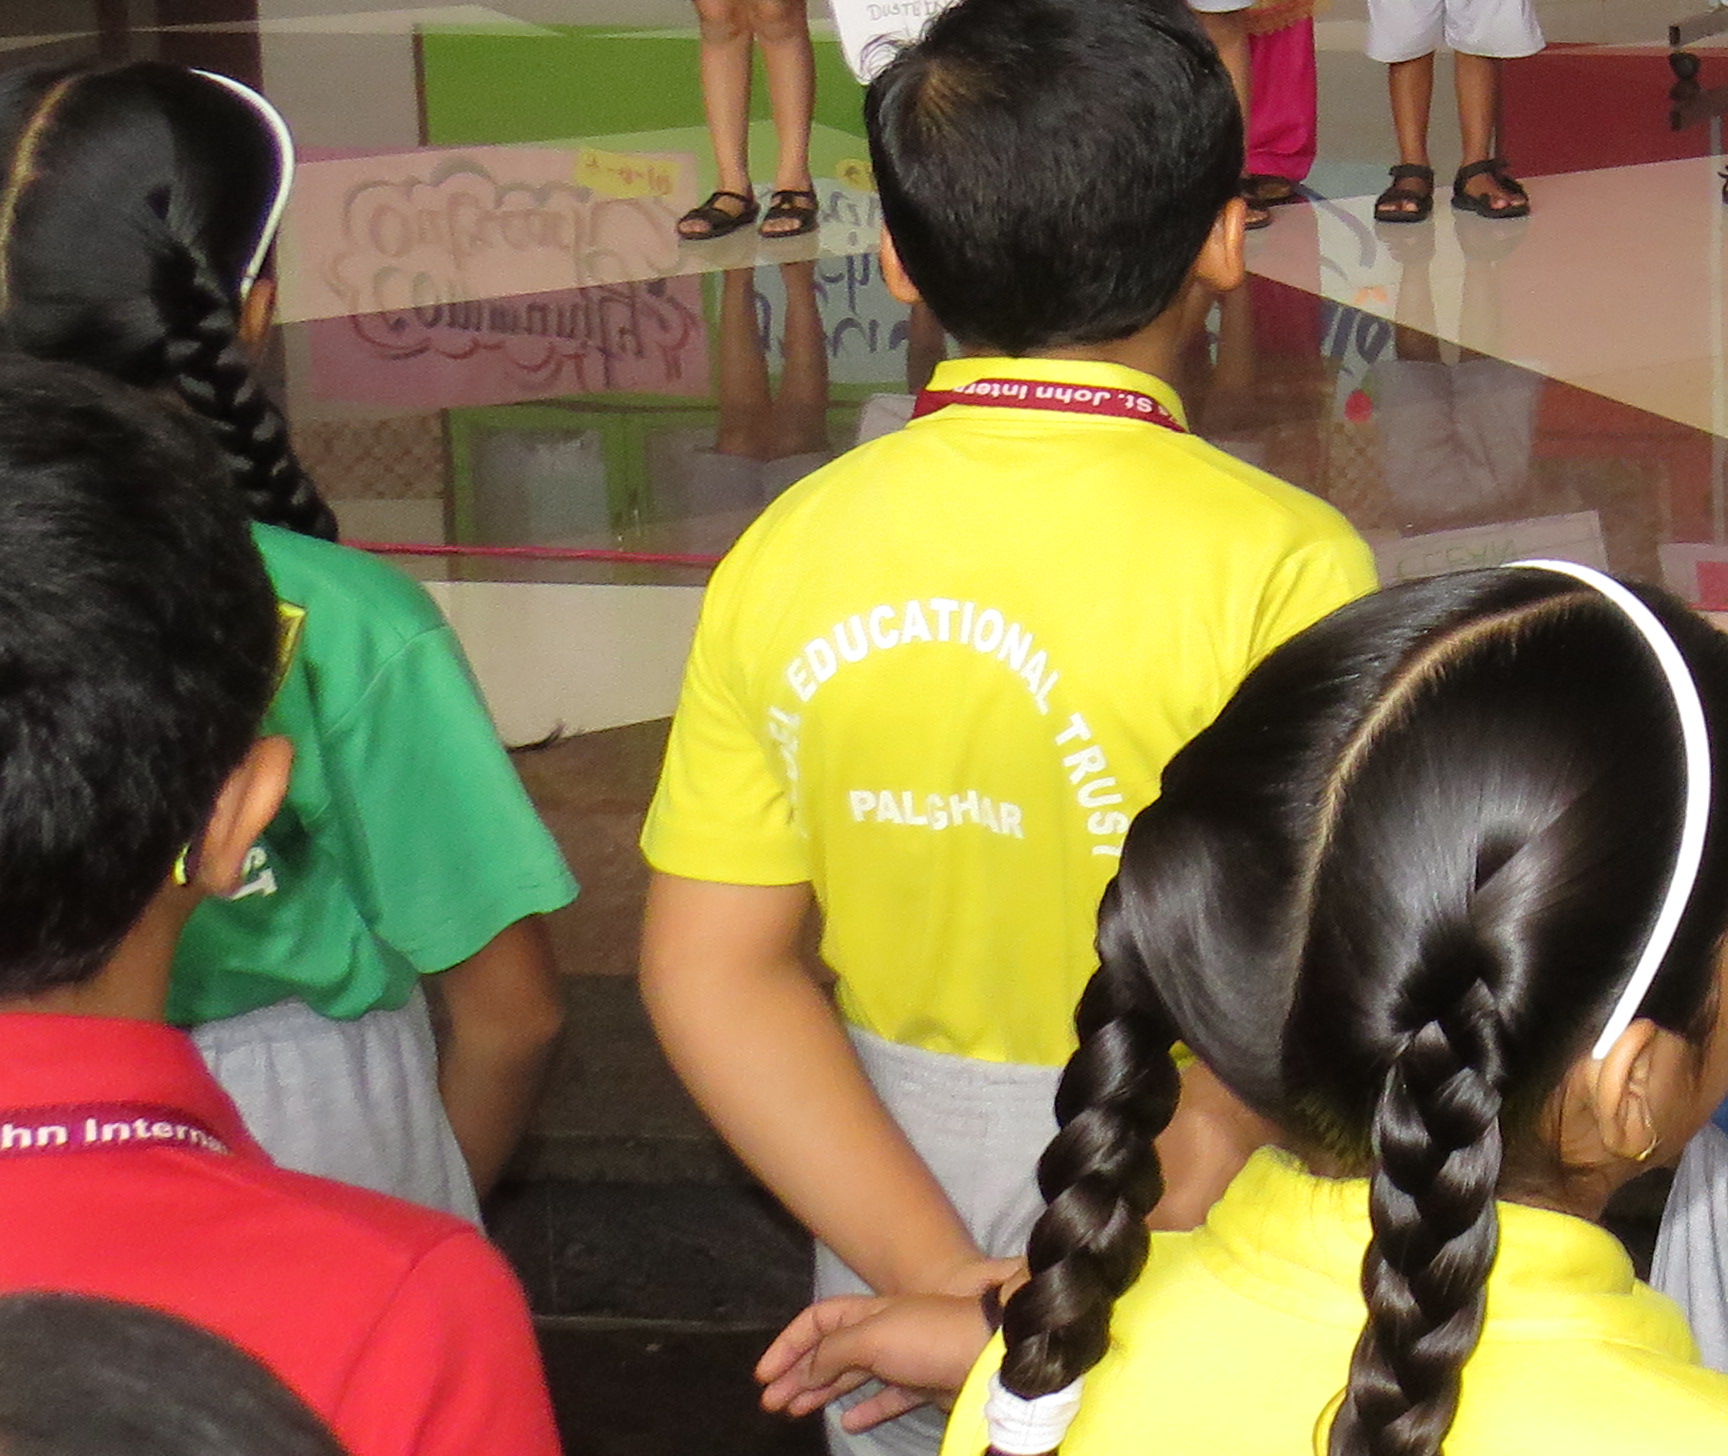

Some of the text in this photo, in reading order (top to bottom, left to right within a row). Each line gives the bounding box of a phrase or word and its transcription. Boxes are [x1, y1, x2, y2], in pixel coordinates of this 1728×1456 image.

[1035, 384, 1111, 407] John
[785, 596, 1131, 858] EDUCATIONAL TRUST
[849, 788, 1026, 840] PALGHAR
